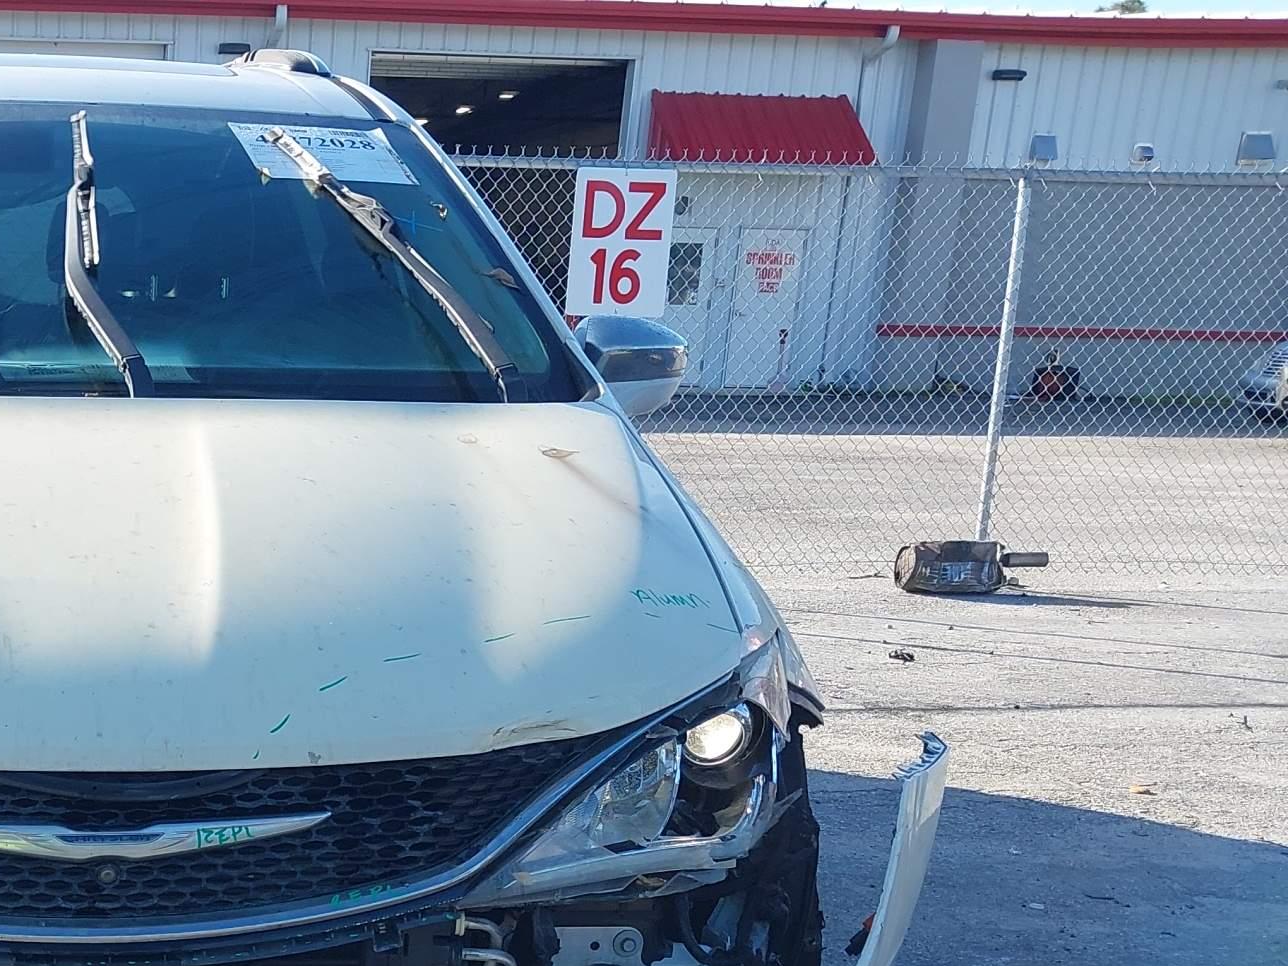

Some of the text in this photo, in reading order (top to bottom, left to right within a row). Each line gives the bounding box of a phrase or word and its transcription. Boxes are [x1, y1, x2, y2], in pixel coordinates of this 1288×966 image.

[255, 134, 376, 150] 472028
[582, 180, 667, 240] DZ
[590, 248, 642, 304] 16
